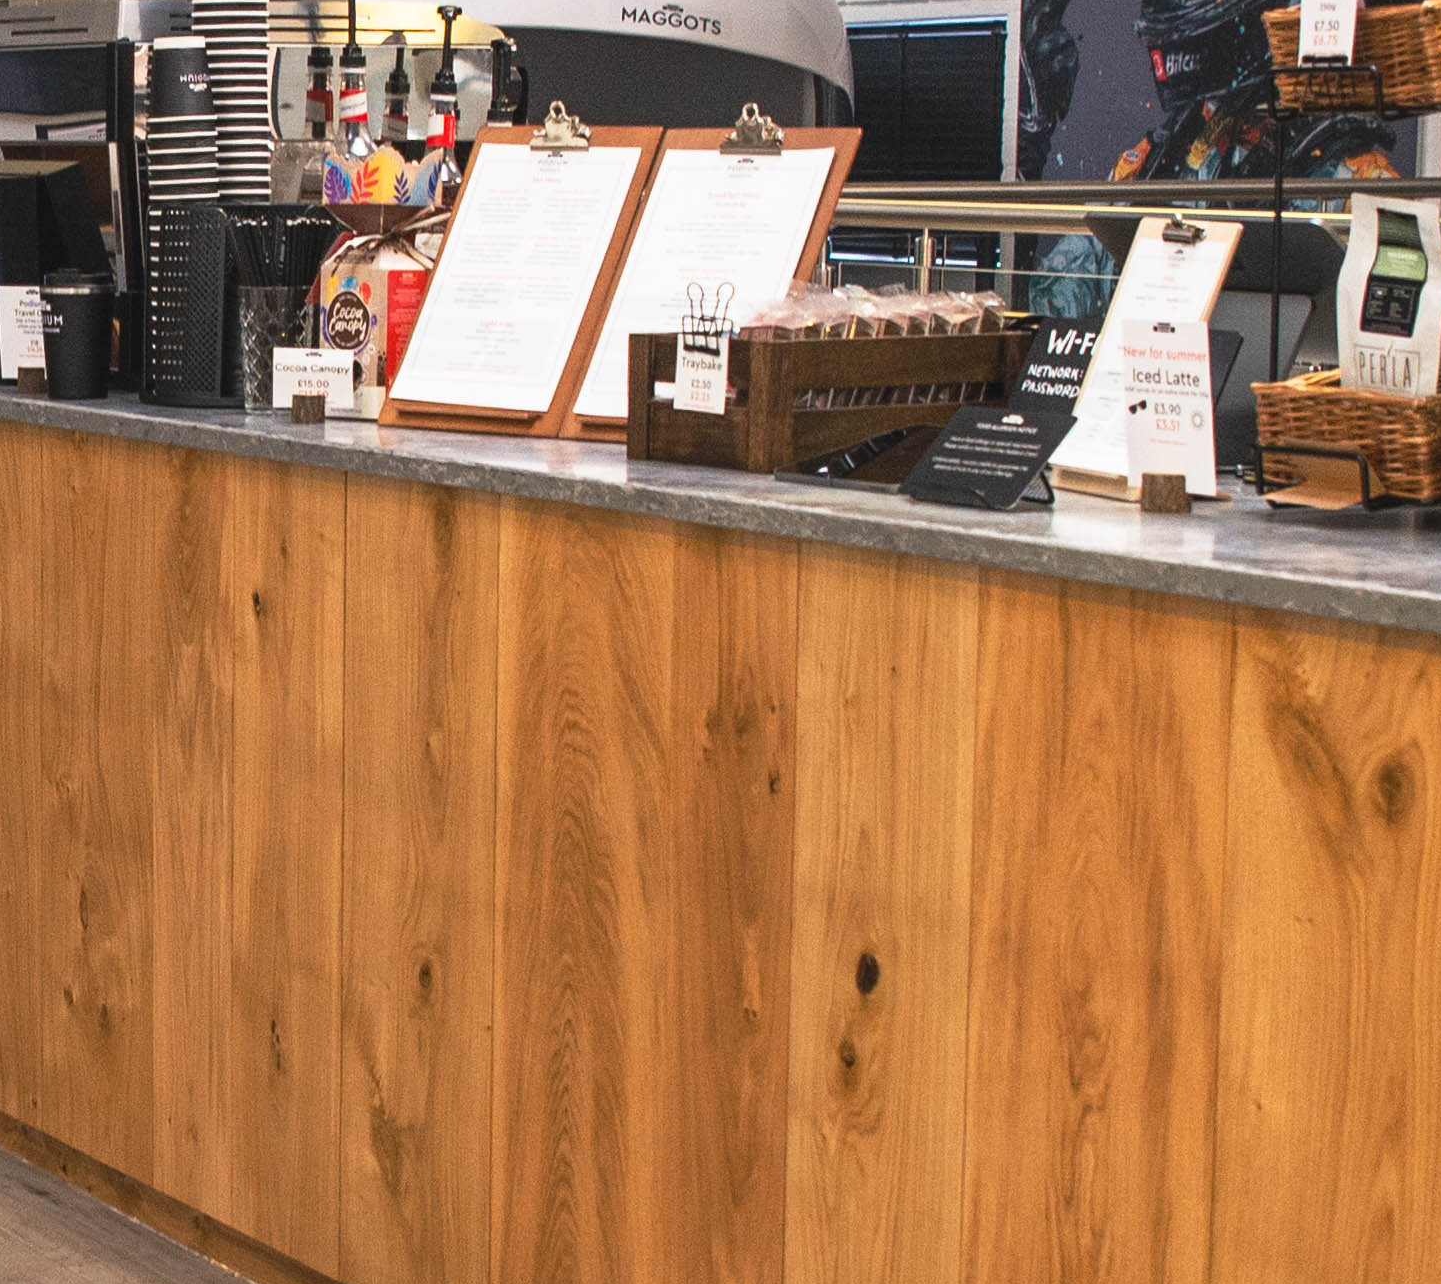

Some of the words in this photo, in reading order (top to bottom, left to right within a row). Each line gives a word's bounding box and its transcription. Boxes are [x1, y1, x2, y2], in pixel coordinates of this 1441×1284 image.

[621, 6, 722, 35] MAGGOTS
[1314, 19, 1339, 31] £7.50
[333, 302, 363, 319] Cocoa
[329, 316, 366, 341] Canopy
[1124, 347, 1146, 357] New
[1149, 346, 1163, 358] for
[1166, 350, 1206, 361] summer
[275, 364, 308, 373] Cocoa
[311, 365, 350, 375] Canopy
[682, 357, 723, 371] Traybake
[1358, 349, 1412, 389] PERLA
[298, 379, 330, 389] £15.00
[1132, 368, 1162, 384] Iced
[1165, 370, 1201, 387] Latte
[1154, 402, 1182, 415] £3.90
